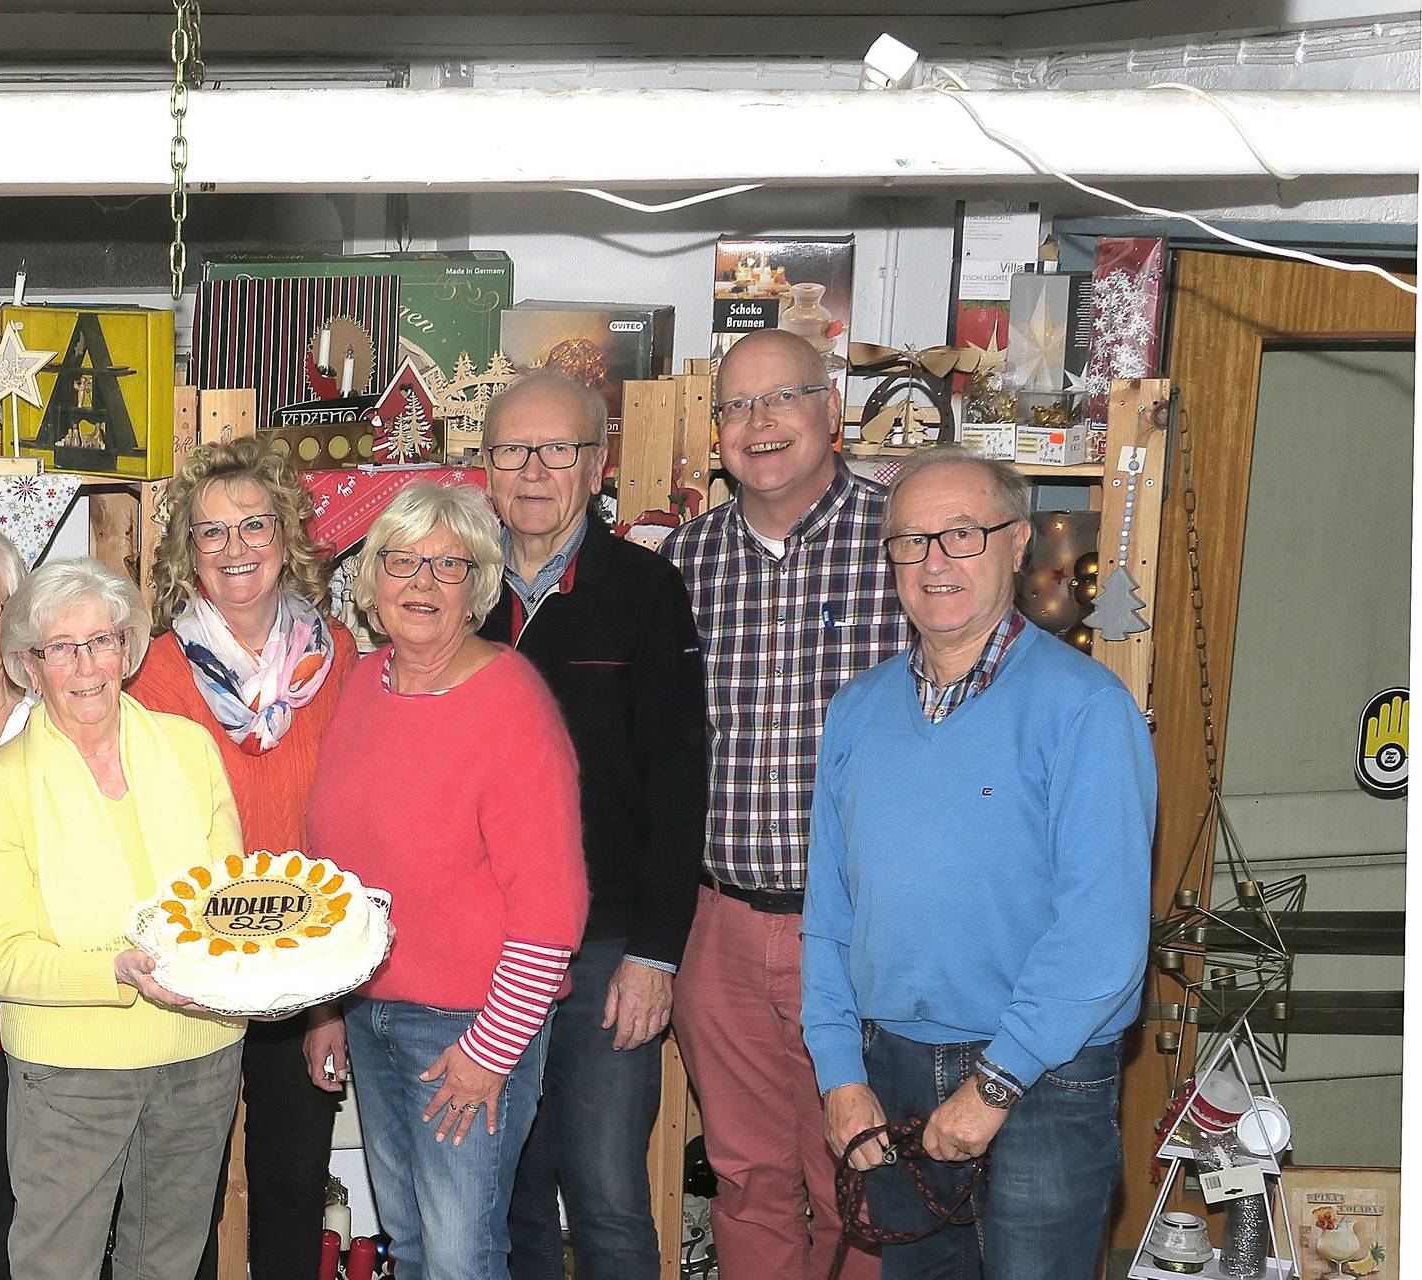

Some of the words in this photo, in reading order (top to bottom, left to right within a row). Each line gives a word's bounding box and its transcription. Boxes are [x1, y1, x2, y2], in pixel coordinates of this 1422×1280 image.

[1004, 202, 1027, 213] Villa
[445, 267, 465, 275] Made
[474, 267, 506, 275] Germany
[1000, 262, 1024, 273] Villa
[730, 303, 763, 315] Schoko
[611, 321, 642, 331] OVITEC
[726, 316, 765, 328] Brunnen
[203, 895, 307, 916] ANDHERI
[229, 913, 285, 931] 25
